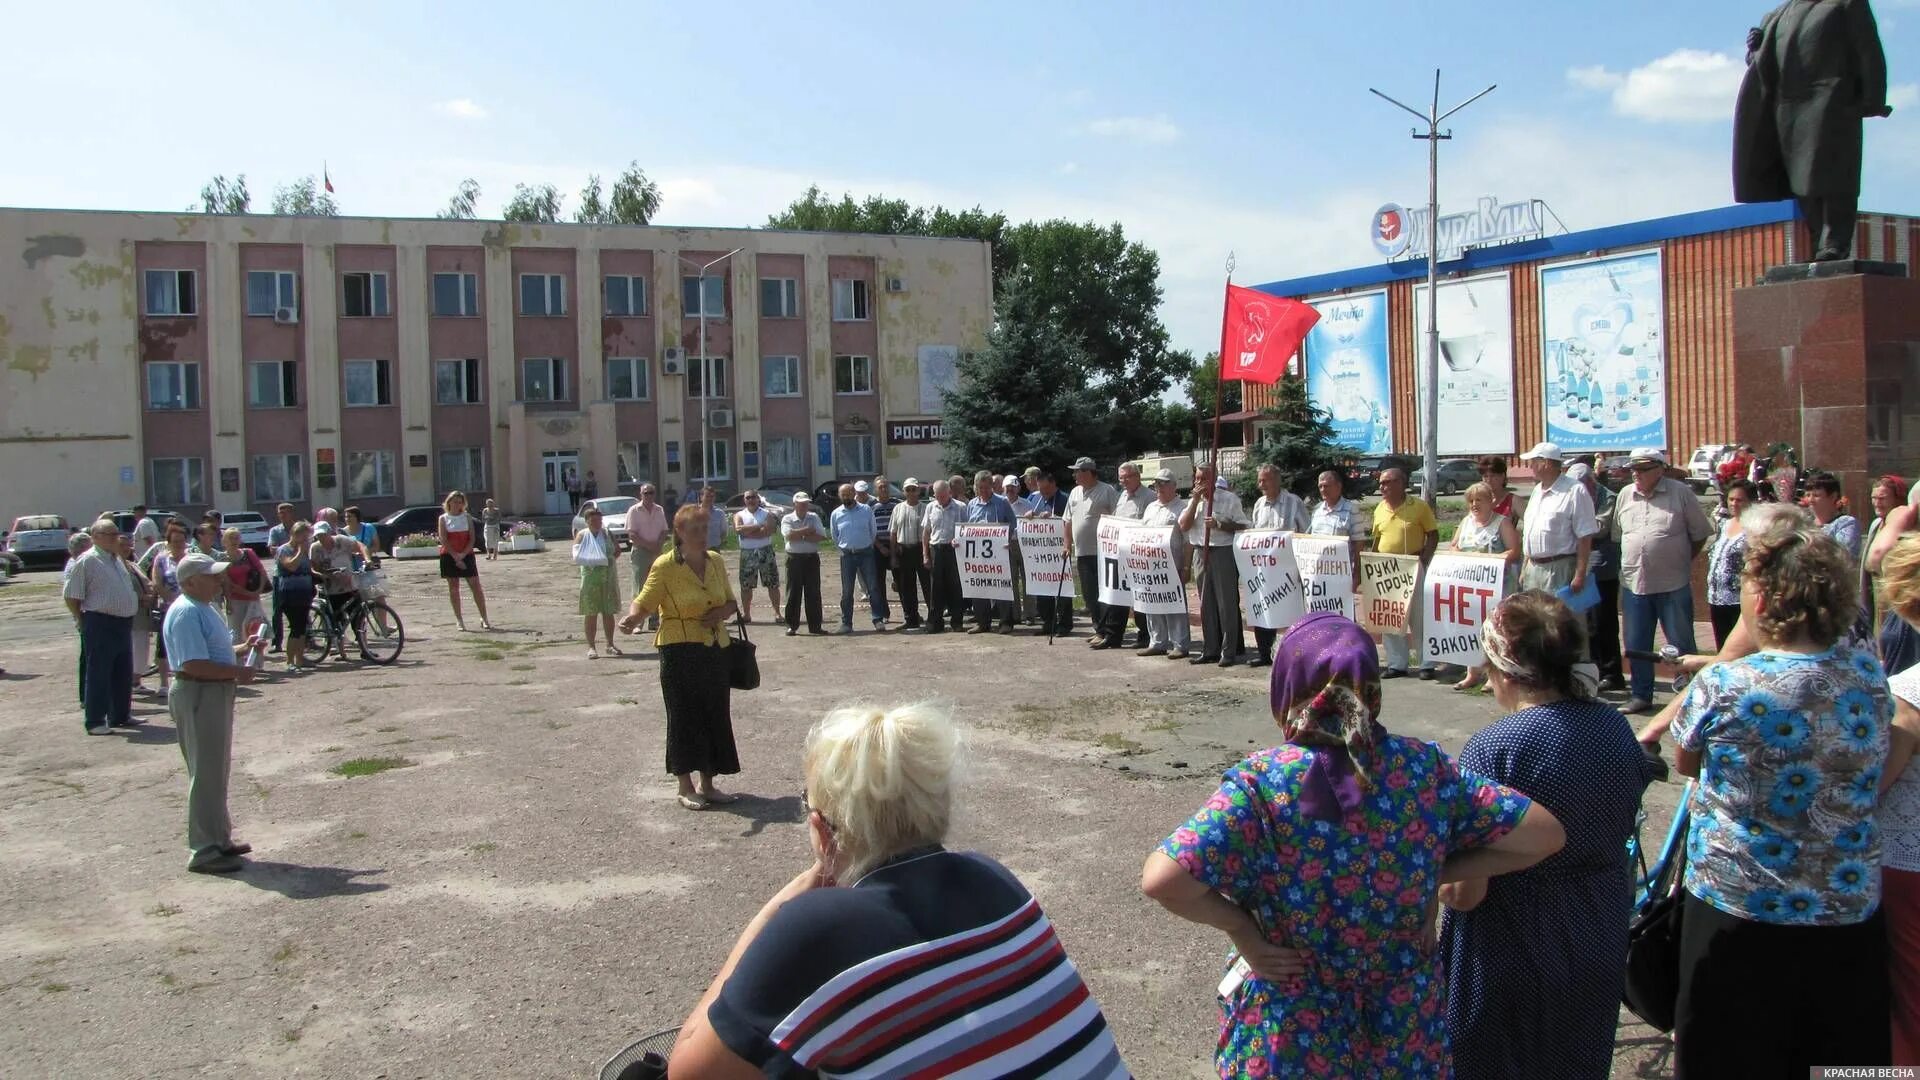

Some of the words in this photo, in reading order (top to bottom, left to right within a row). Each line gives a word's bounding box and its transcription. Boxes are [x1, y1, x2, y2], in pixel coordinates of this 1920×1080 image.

[1021, 537, 1064, 547] ПРАВИТЕЛЬСТВ
[1126, 530, 1164, 544] ЕБУЕМ
[1130, 544, 1168, 559] СНИЗИТЬ
[1126, 558, 1150, 570] ЦЕНЫ
[1250, 554, 1277, 568] ЕСТЬ
[1365, 558, 1400, 580] РУКИ
[1132, 572, 1170, 586] БЕНЗИН
[1376, 572, 1414, 596] ПРОЧЬ
[1303, 578, 1326, 597] ВЫ
[1434, 582, 1494, 627] НЕТ
[1369, 612, 1406, 629] ЧЕЛОВ
